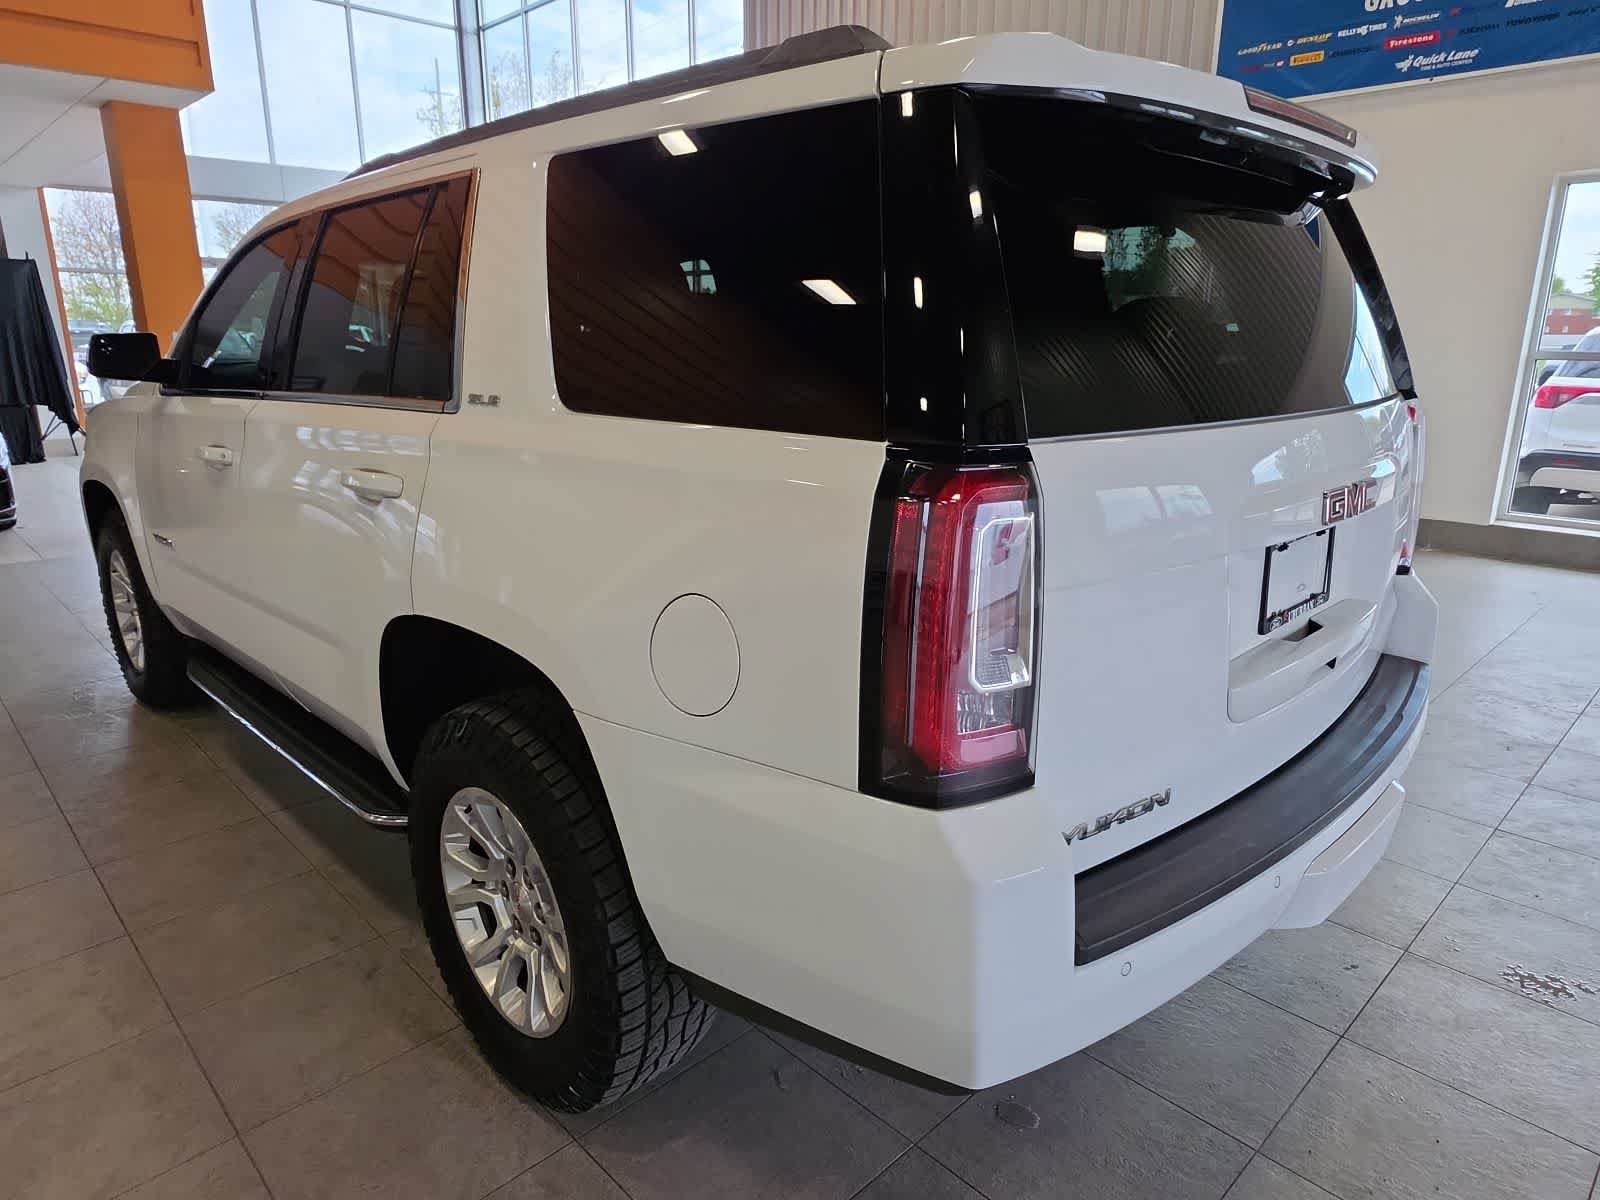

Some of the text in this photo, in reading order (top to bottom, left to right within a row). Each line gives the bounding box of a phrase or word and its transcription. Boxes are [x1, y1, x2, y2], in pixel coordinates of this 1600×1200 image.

[1390, 35, 1434, 48] Firestone
[1413, 49, 1479, 67] Quick Lane
[1322, 479, 1377, 525] GMC
[1061, 787, 1172, 846] YUKON
